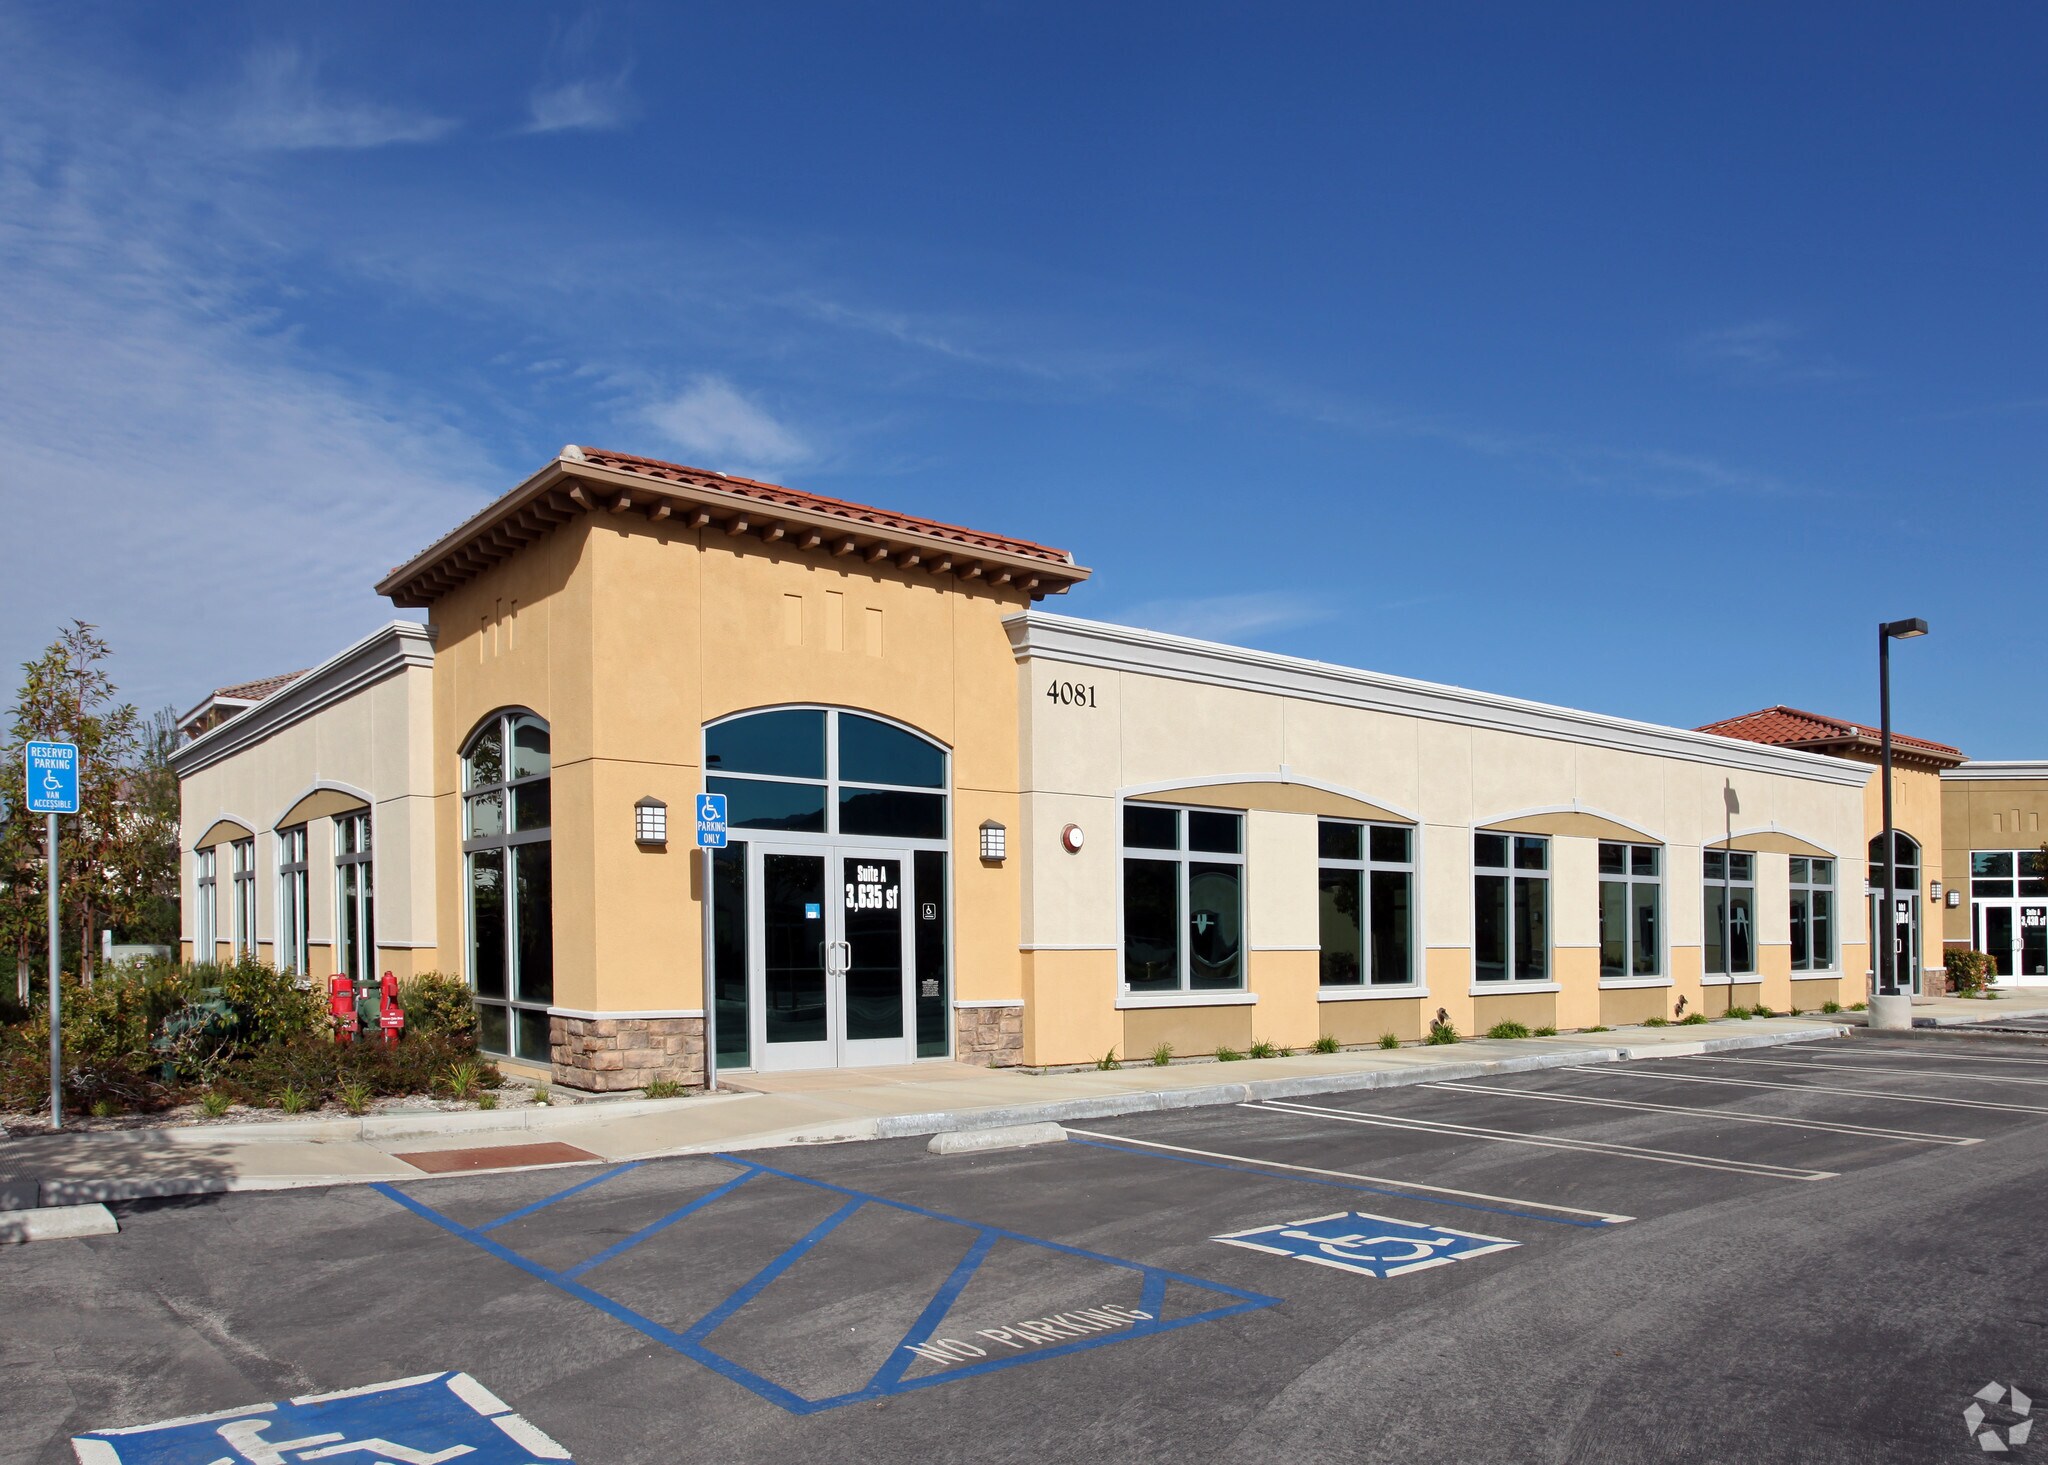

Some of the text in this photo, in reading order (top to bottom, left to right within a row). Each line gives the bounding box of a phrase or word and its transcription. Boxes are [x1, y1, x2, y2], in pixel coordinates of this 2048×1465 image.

[1046, 679, 1097, 708] 4081
[31, 746, 73, 759] RESERVED
[34, 758, 70, 770] PARKING
[46, 791, 60, 799] VAN
[34, 799, 72, 809] ACCESSIBLE
[697, 820, 726, 832] PARKING
[703, 833, 720, 844] ONLY
[857, 864, 887, 883] Suite A
[845, 883, 899, 912] 3,635 sf
[903, 1304, 1154, 1365] NO PARKING
